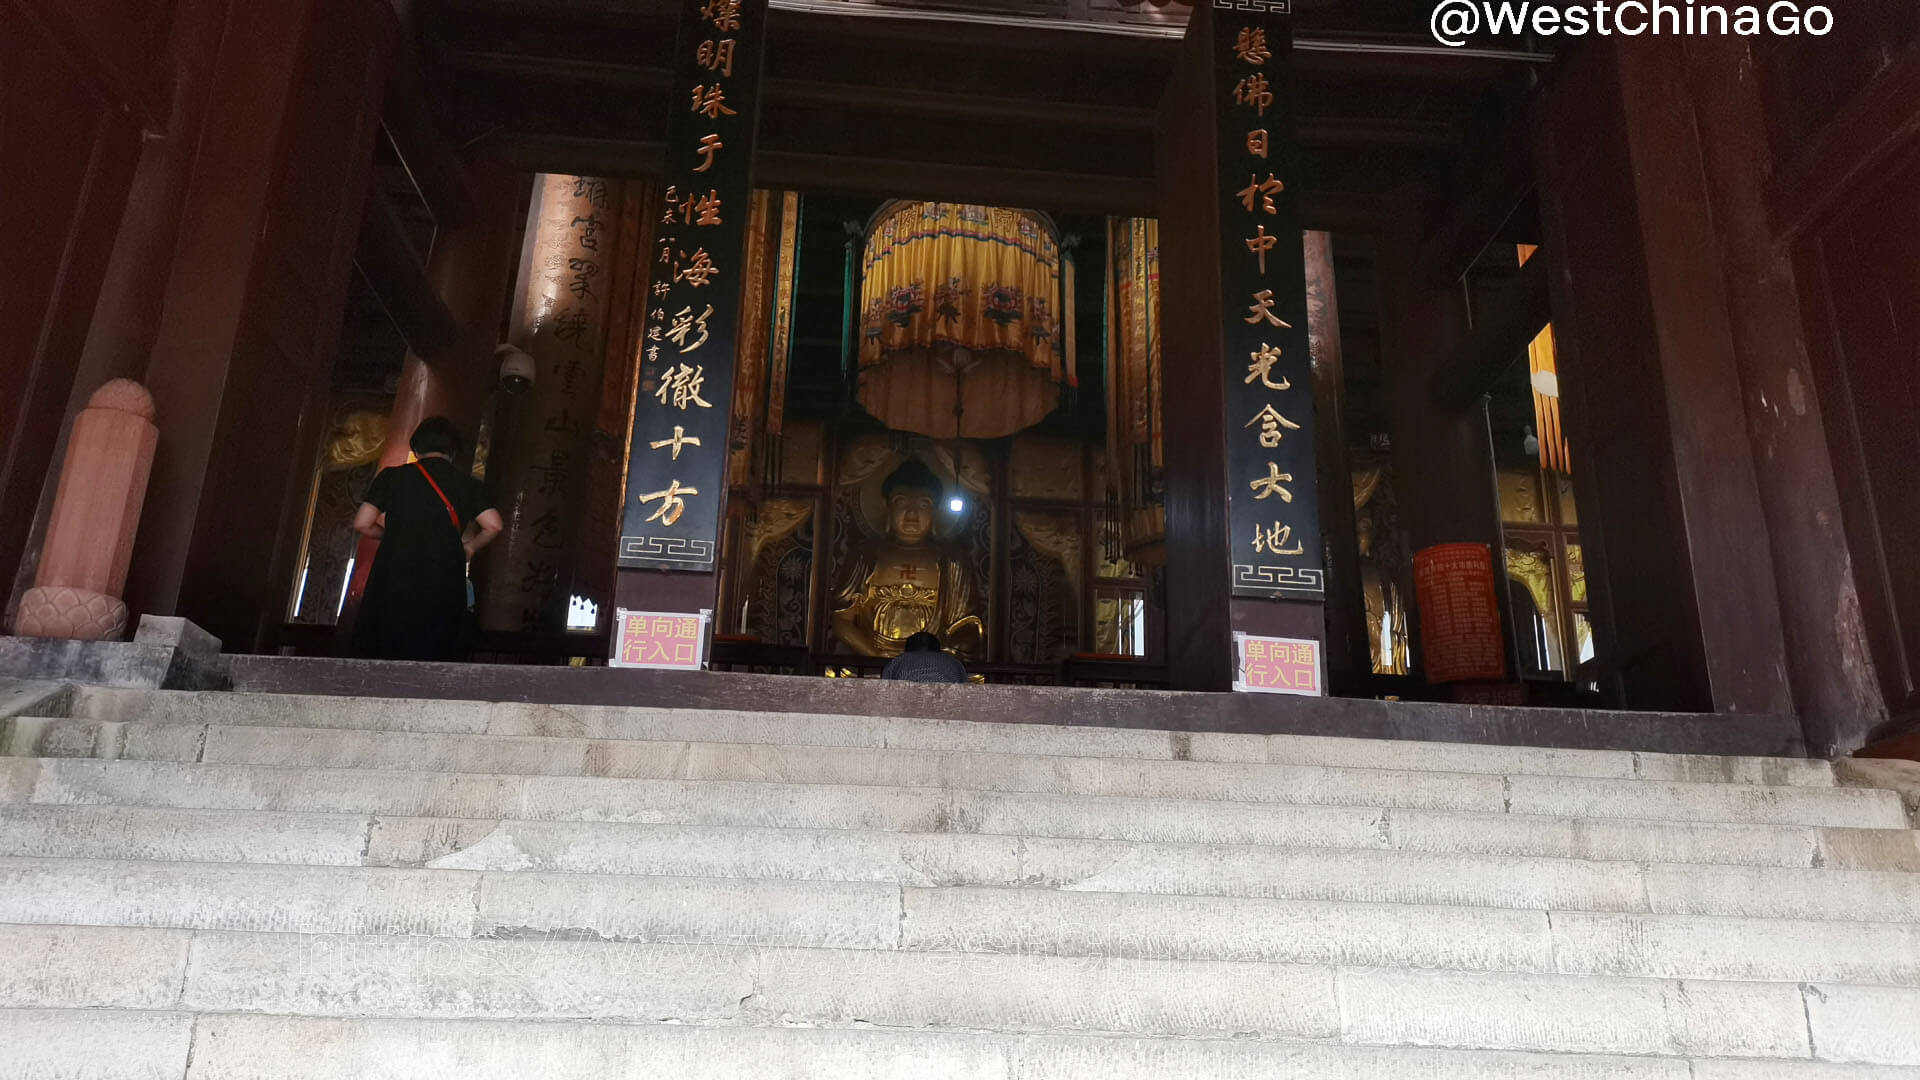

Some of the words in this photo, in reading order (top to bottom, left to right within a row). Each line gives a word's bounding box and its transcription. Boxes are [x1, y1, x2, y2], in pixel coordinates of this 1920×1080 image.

[626, 616, 697, 639] 单向通
[624, 640, 695, 662] 行入口
[1246, 641, 1313, 665] 单向通
[1245, 663, 1313, 688] 行入口
